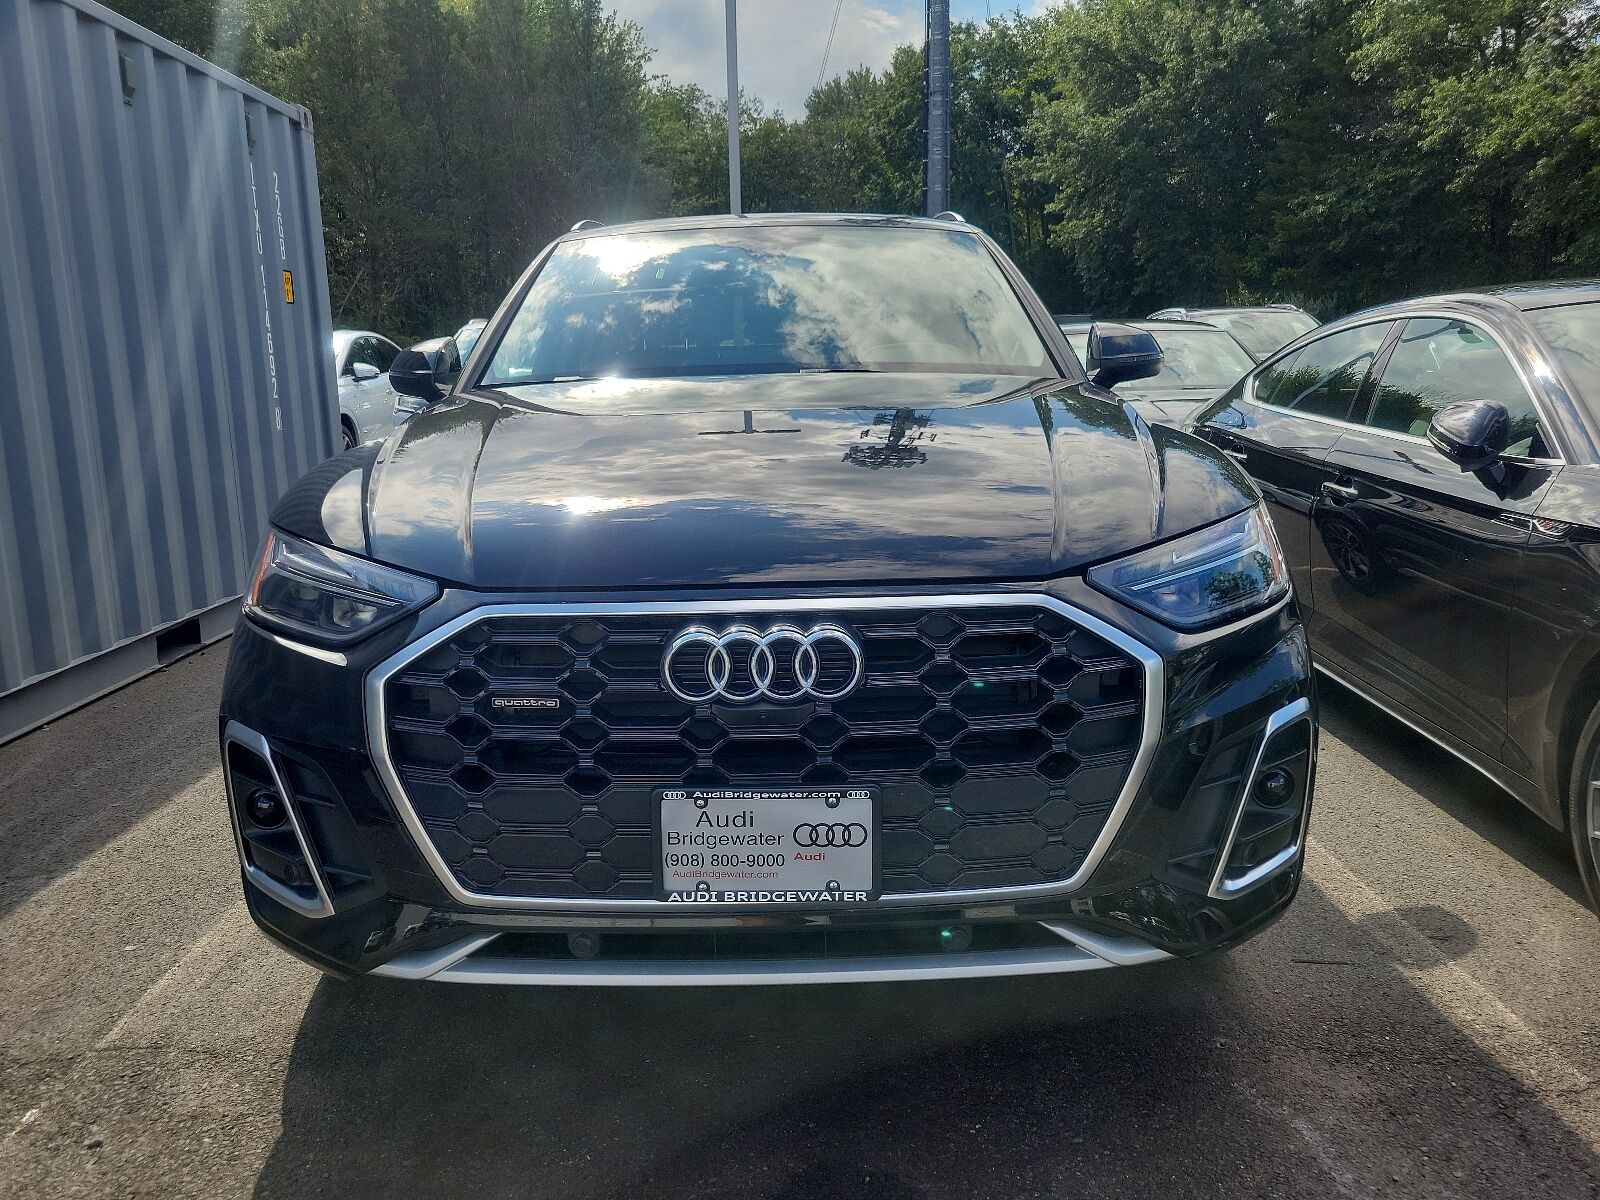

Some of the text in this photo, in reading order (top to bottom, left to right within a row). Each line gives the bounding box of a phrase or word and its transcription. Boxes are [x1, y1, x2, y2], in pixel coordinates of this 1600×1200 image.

[693, 791, 841, 799] AudiBridgewater.com
[695, 811, 754, 828] Audi
[667, 831, 785, 849] Bridgewater
[665, 853, 785, 868] (908) 800-9000
[793, 853, 826, 861] Audi
[672, 870, 779, 880] AudiBridgewater.com
[668, 892, 868, 902] AUDI BRIDGEWATER
